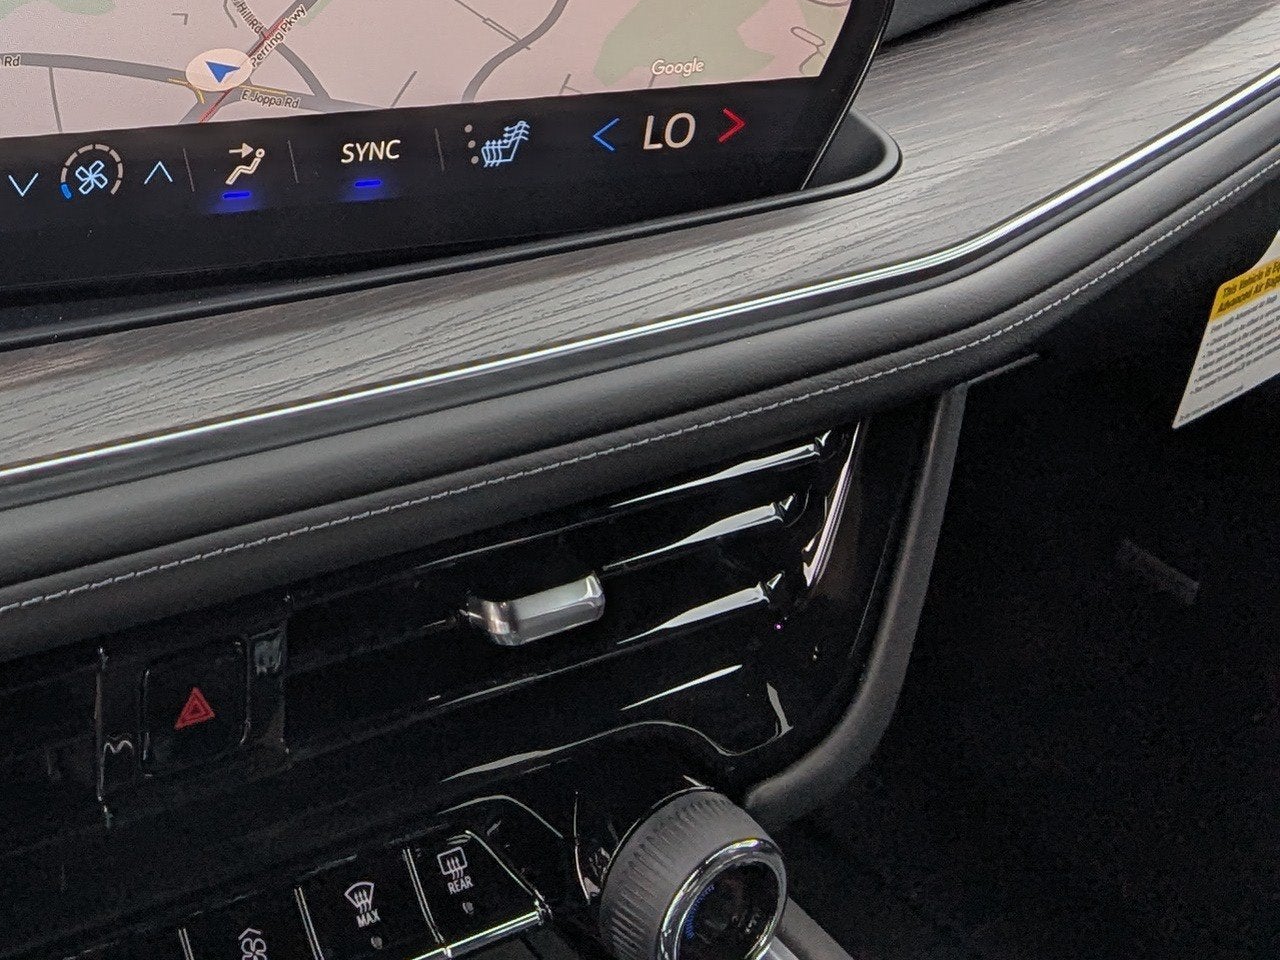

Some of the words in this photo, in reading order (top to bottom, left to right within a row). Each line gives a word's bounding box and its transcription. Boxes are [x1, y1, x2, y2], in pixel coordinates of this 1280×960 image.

[236, 0, 255, 25] Hill
[248, 19, 263, 35] Rd
[250, 31, 285, 68] Perring
[279, 5, 307, 33] Pkwy
[3, 56, 20, 67] Rd
[651, 57, 705, 78] Google
[241, 90, 249, 101] E
[251, 92, 281, 108] Joppa
[283, 97, 299, 108] Rd
[642, 111, 697, 151] LO
[340, 139, 401, 165] SYNC
[447, 875, 474, 895] REAR
[356, 908, 382, 927] MAX
